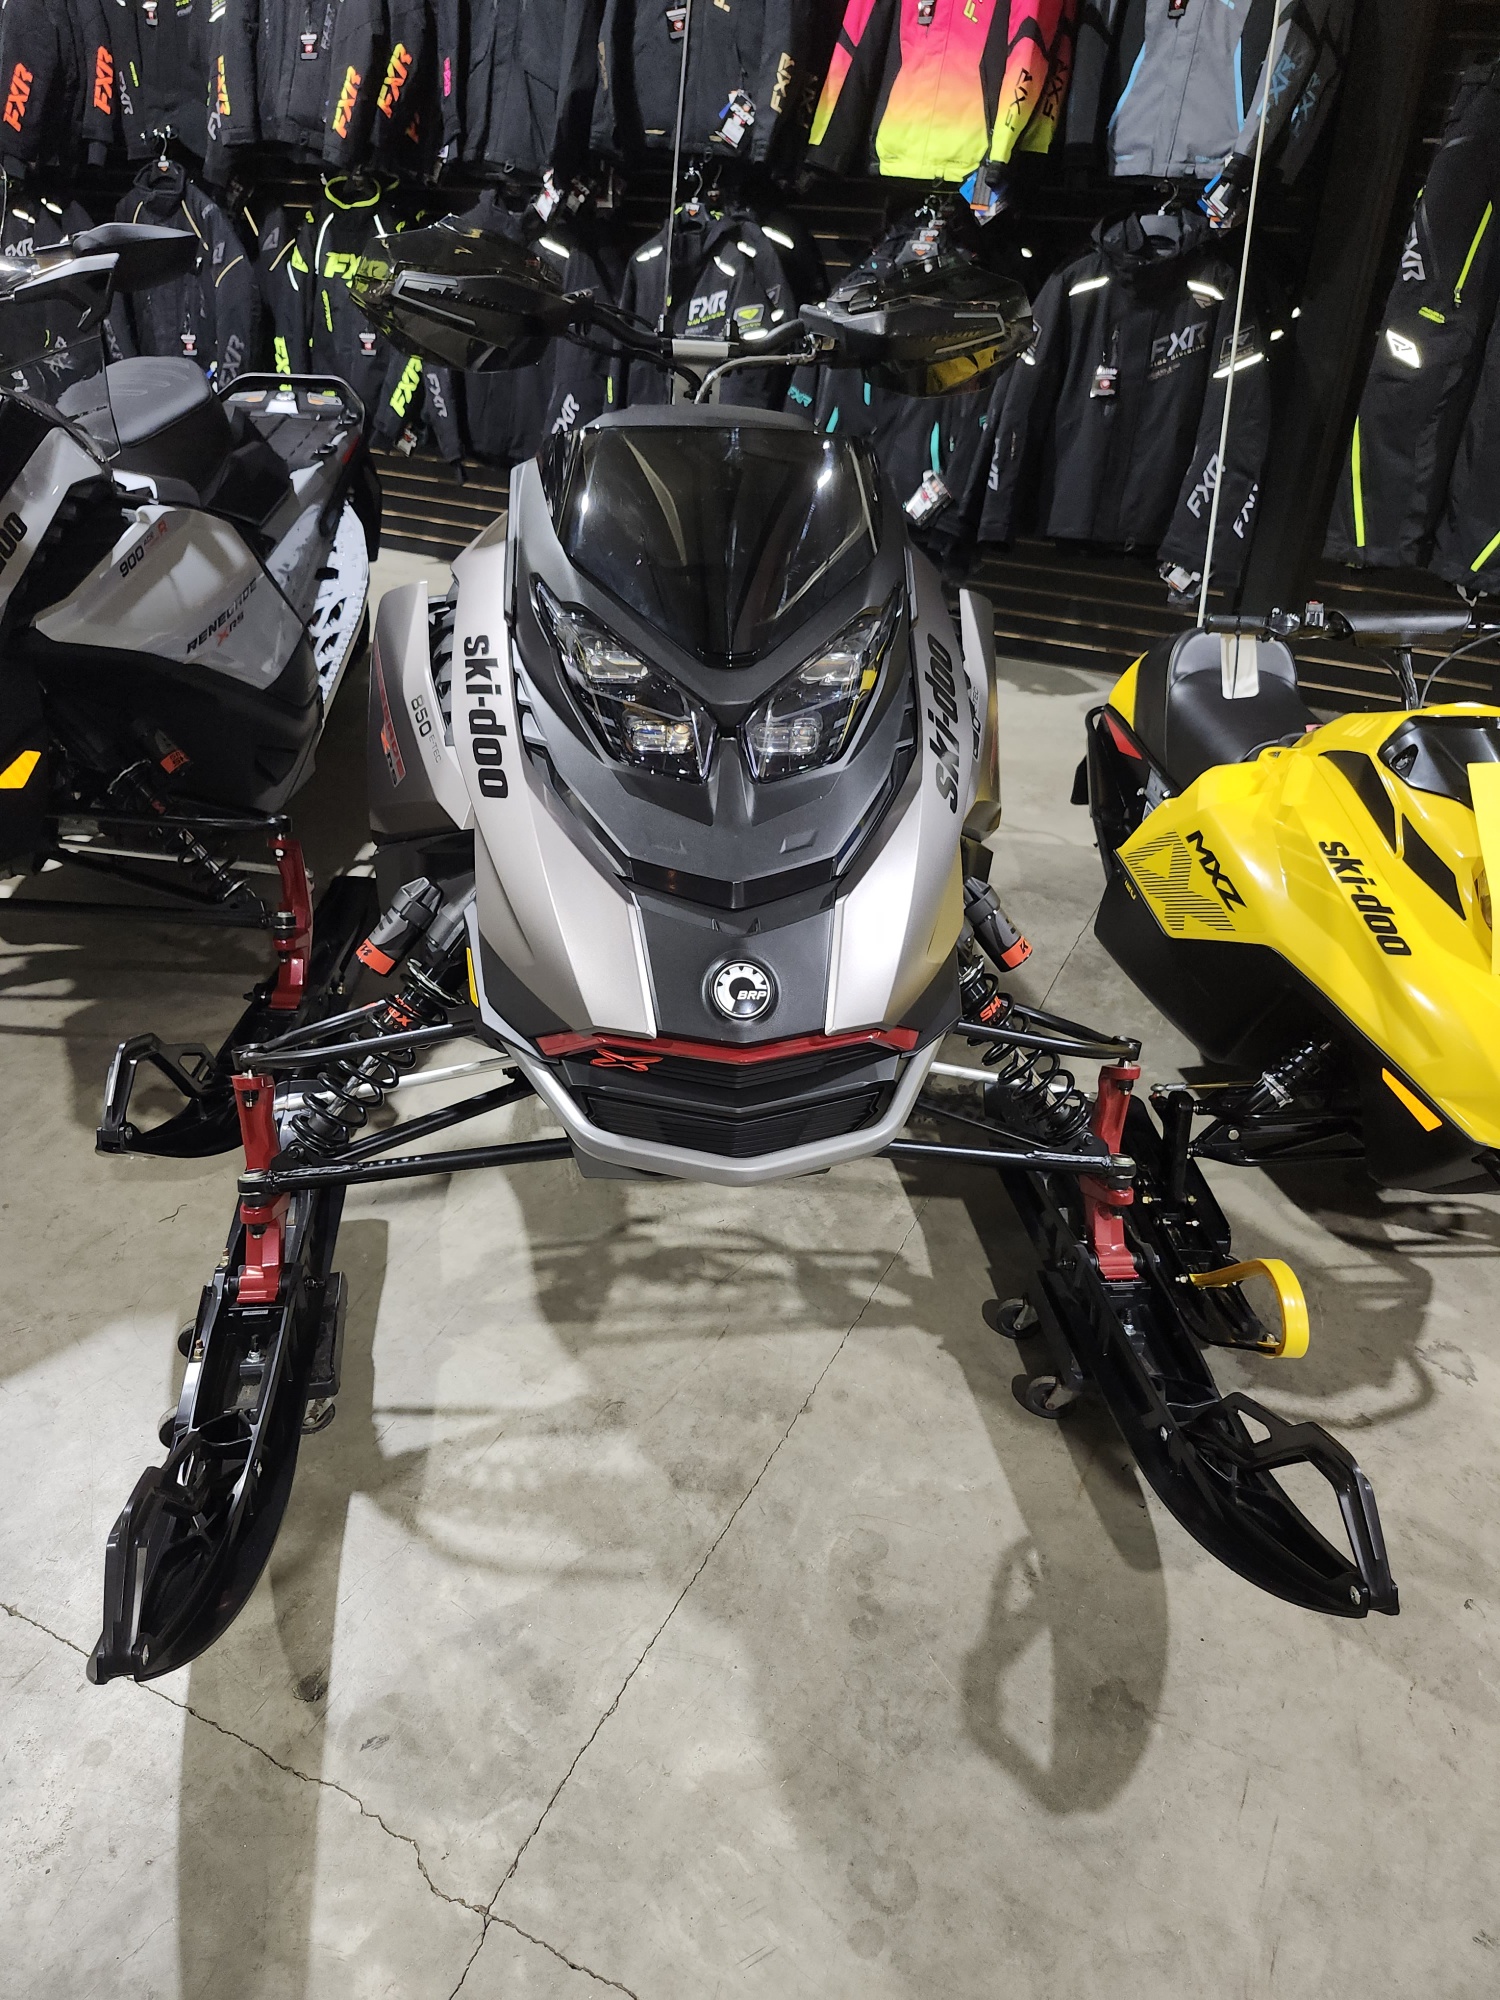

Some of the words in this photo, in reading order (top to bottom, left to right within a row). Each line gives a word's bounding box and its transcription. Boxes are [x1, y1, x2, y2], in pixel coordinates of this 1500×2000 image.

[3, 63, 33, 132] FXR
[93, 46, 113, 115] FXR
[332, 66, 361, 138] FXR
[377, 43, 412, 118] FXR
[770, 52, 795, 113] FXR
[1005, 68, 1033, 132] FXR
[1042, 58, 1069, 121] FXR
[1401, 221, 1426, 282] FXR
[688, 290, 728, 321] FXR
[1151, 321, 1208, 362] FXR
[390, 355, 423, 418] FXR
[1186, 453, 1226, 519] FXR
[119, 545, 145, 578] 900
[187, 577, 258, 654] RENEGADE
[411, 694, 432, 738] 850
[428, 734, 442, 763] E-TEC
[464, 635, 508, 799] ski-doo
[925, 633, 960, 814] ski-doo
[1186, 829, 1247, 913] MXZ
[1318, 841, 1412, 957] ski-doo
[737, 989, 767, 1001] BRP
